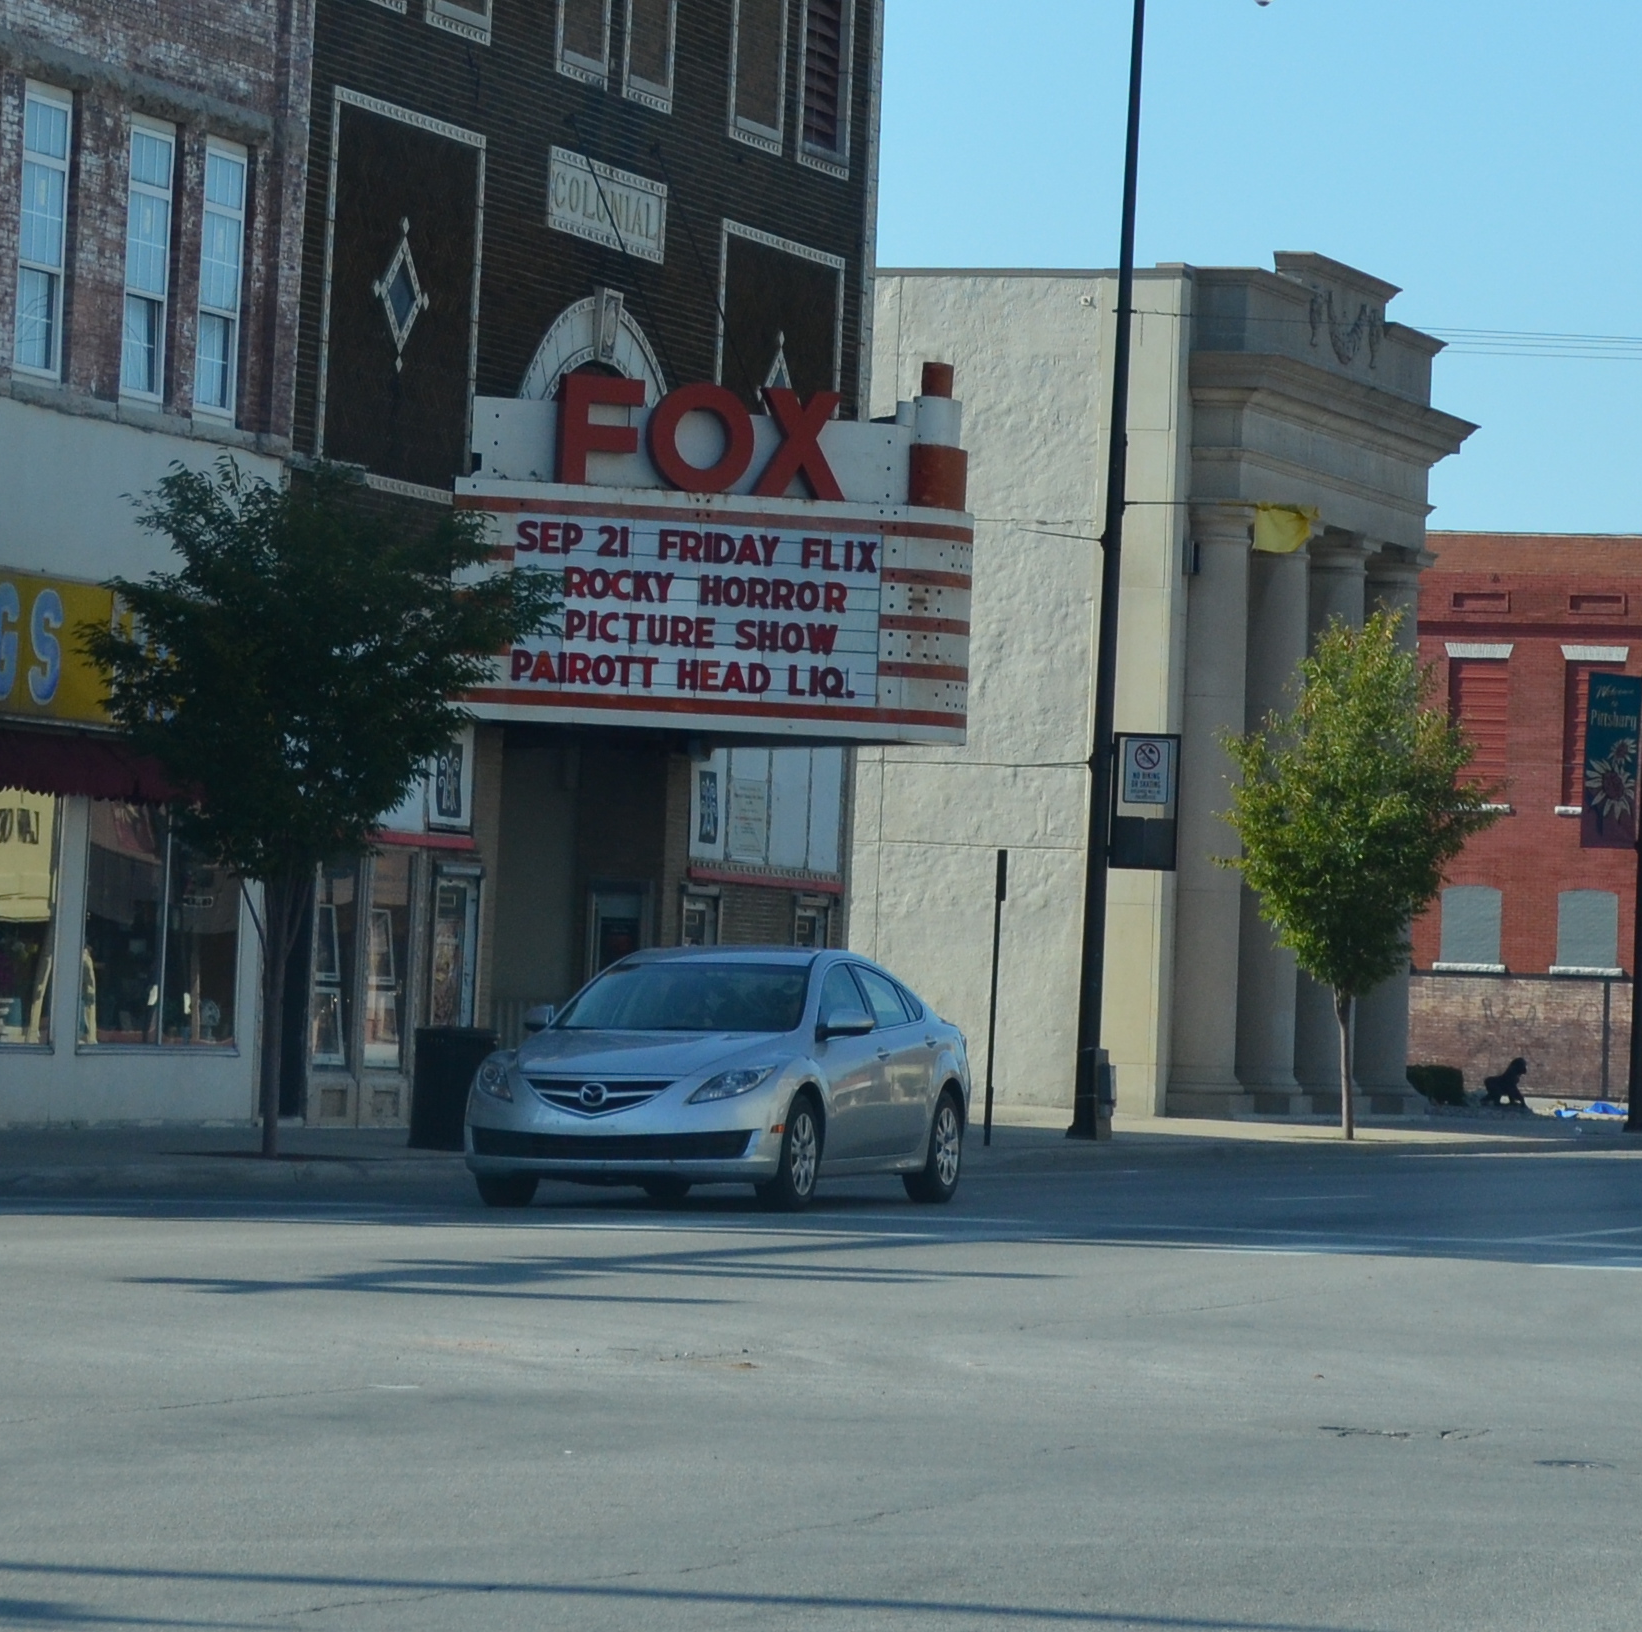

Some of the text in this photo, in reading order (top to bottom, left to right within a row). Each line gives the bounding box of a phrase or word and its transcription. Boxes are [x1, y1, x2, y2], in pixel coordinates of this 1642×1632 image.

[554, 170, 657, 241] COLONIAL
[557, 372, 845, 502] FOX
[516, 519, 878, 574] SEP 21 FRIDAY FLIX
[564, 566, 848, 615] ROCKY HORROR
[565, 609, 839, 656] PICTURE SHOW
[510, 649, 659, 689] PAIROTT
[676, 658, 772, 695] HEAD
[1590, 709, 1638, 732] Pittsburg
